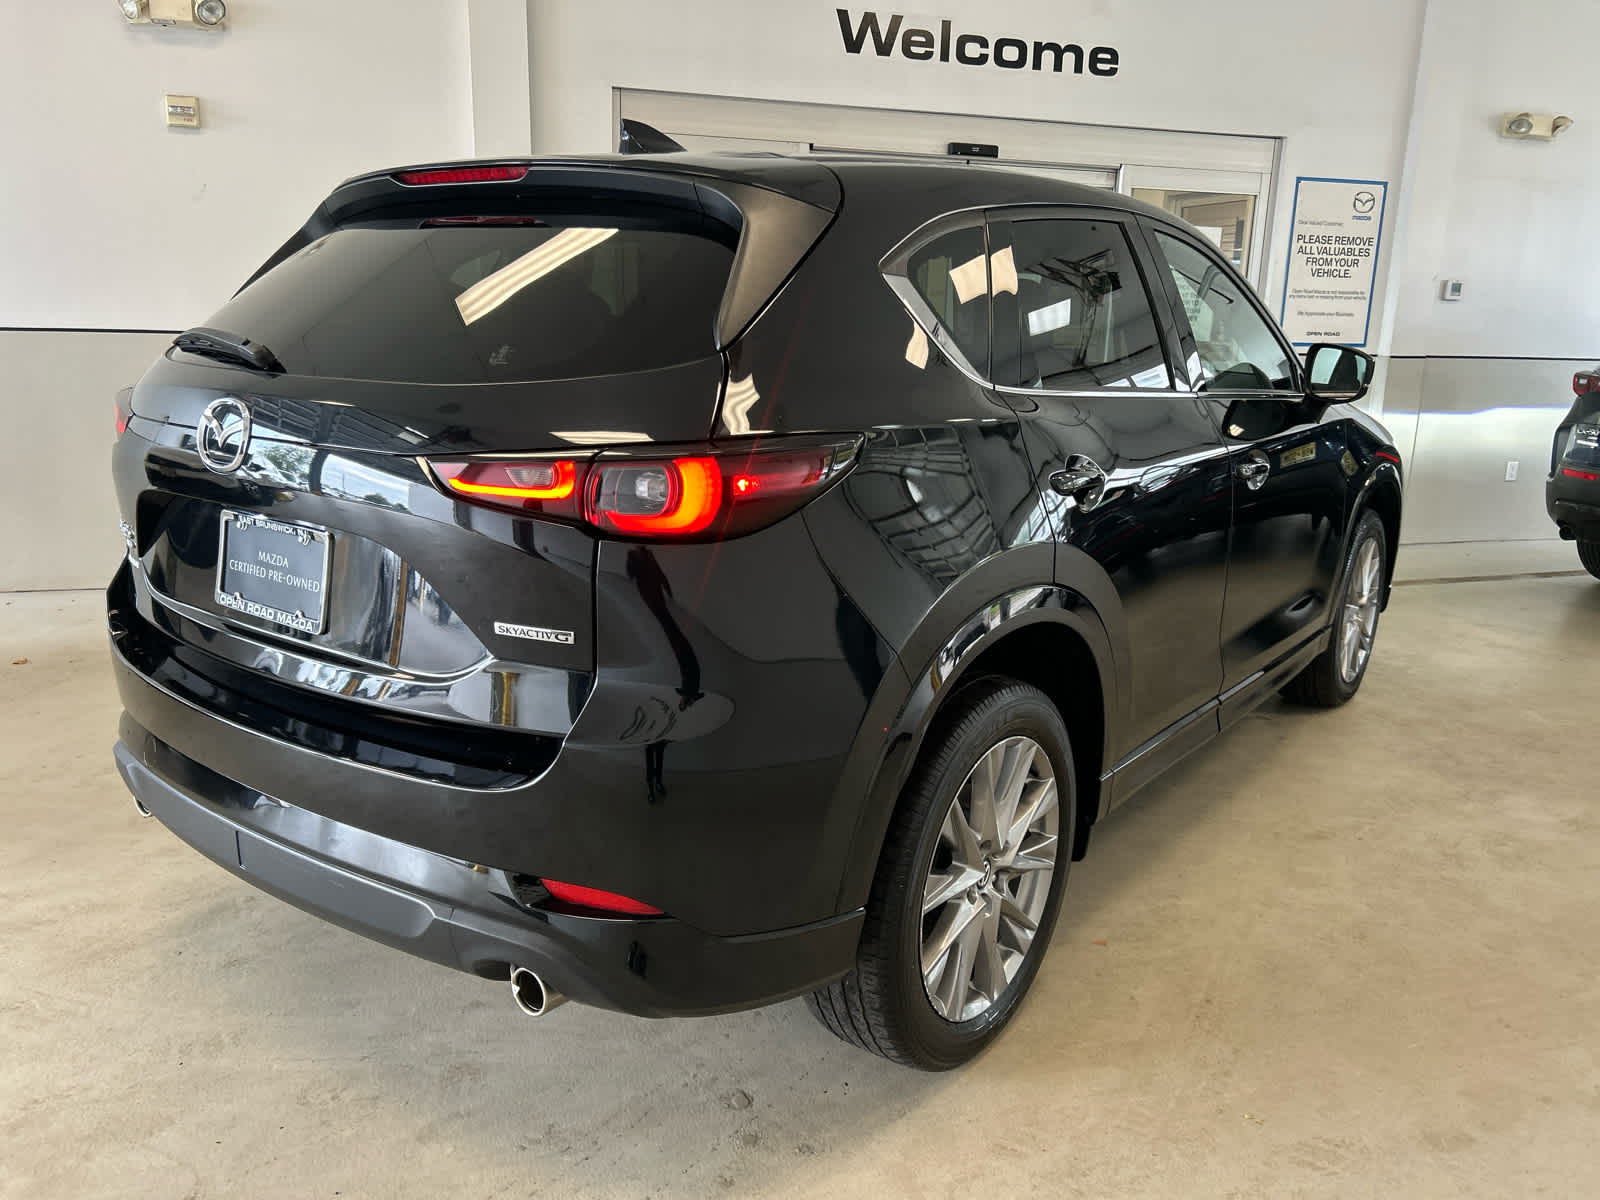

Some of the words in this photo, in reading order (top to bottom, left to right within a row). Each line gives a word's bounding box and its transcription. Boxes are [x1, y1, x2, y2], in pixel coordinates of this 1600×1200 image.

[836, 8, 1119, 77] Welcome
[1297, 234, 1333, 245] PLEASE
[1334, 235, 1374, 247] REMOVE
[1297, 245, 1315, 256] ALL
[1316, 246, 1371, 258] VALUABLES
[1305, 257, 1333, 267] FROM
[1334, 258, 1360, 268] YOUR
[1311, 268, 1352, 279] VEHICLE.
[258, 551, 289, 569] MAZDA
[229, 559, 266, 578] CERTIFIED
[268, 569, 320, 593] PRE-OWNED
[219, 594, 245, 611] OPEN
[246, 601, 275, 619] ROAD
[277, 612, 313, 632] MAZDA
